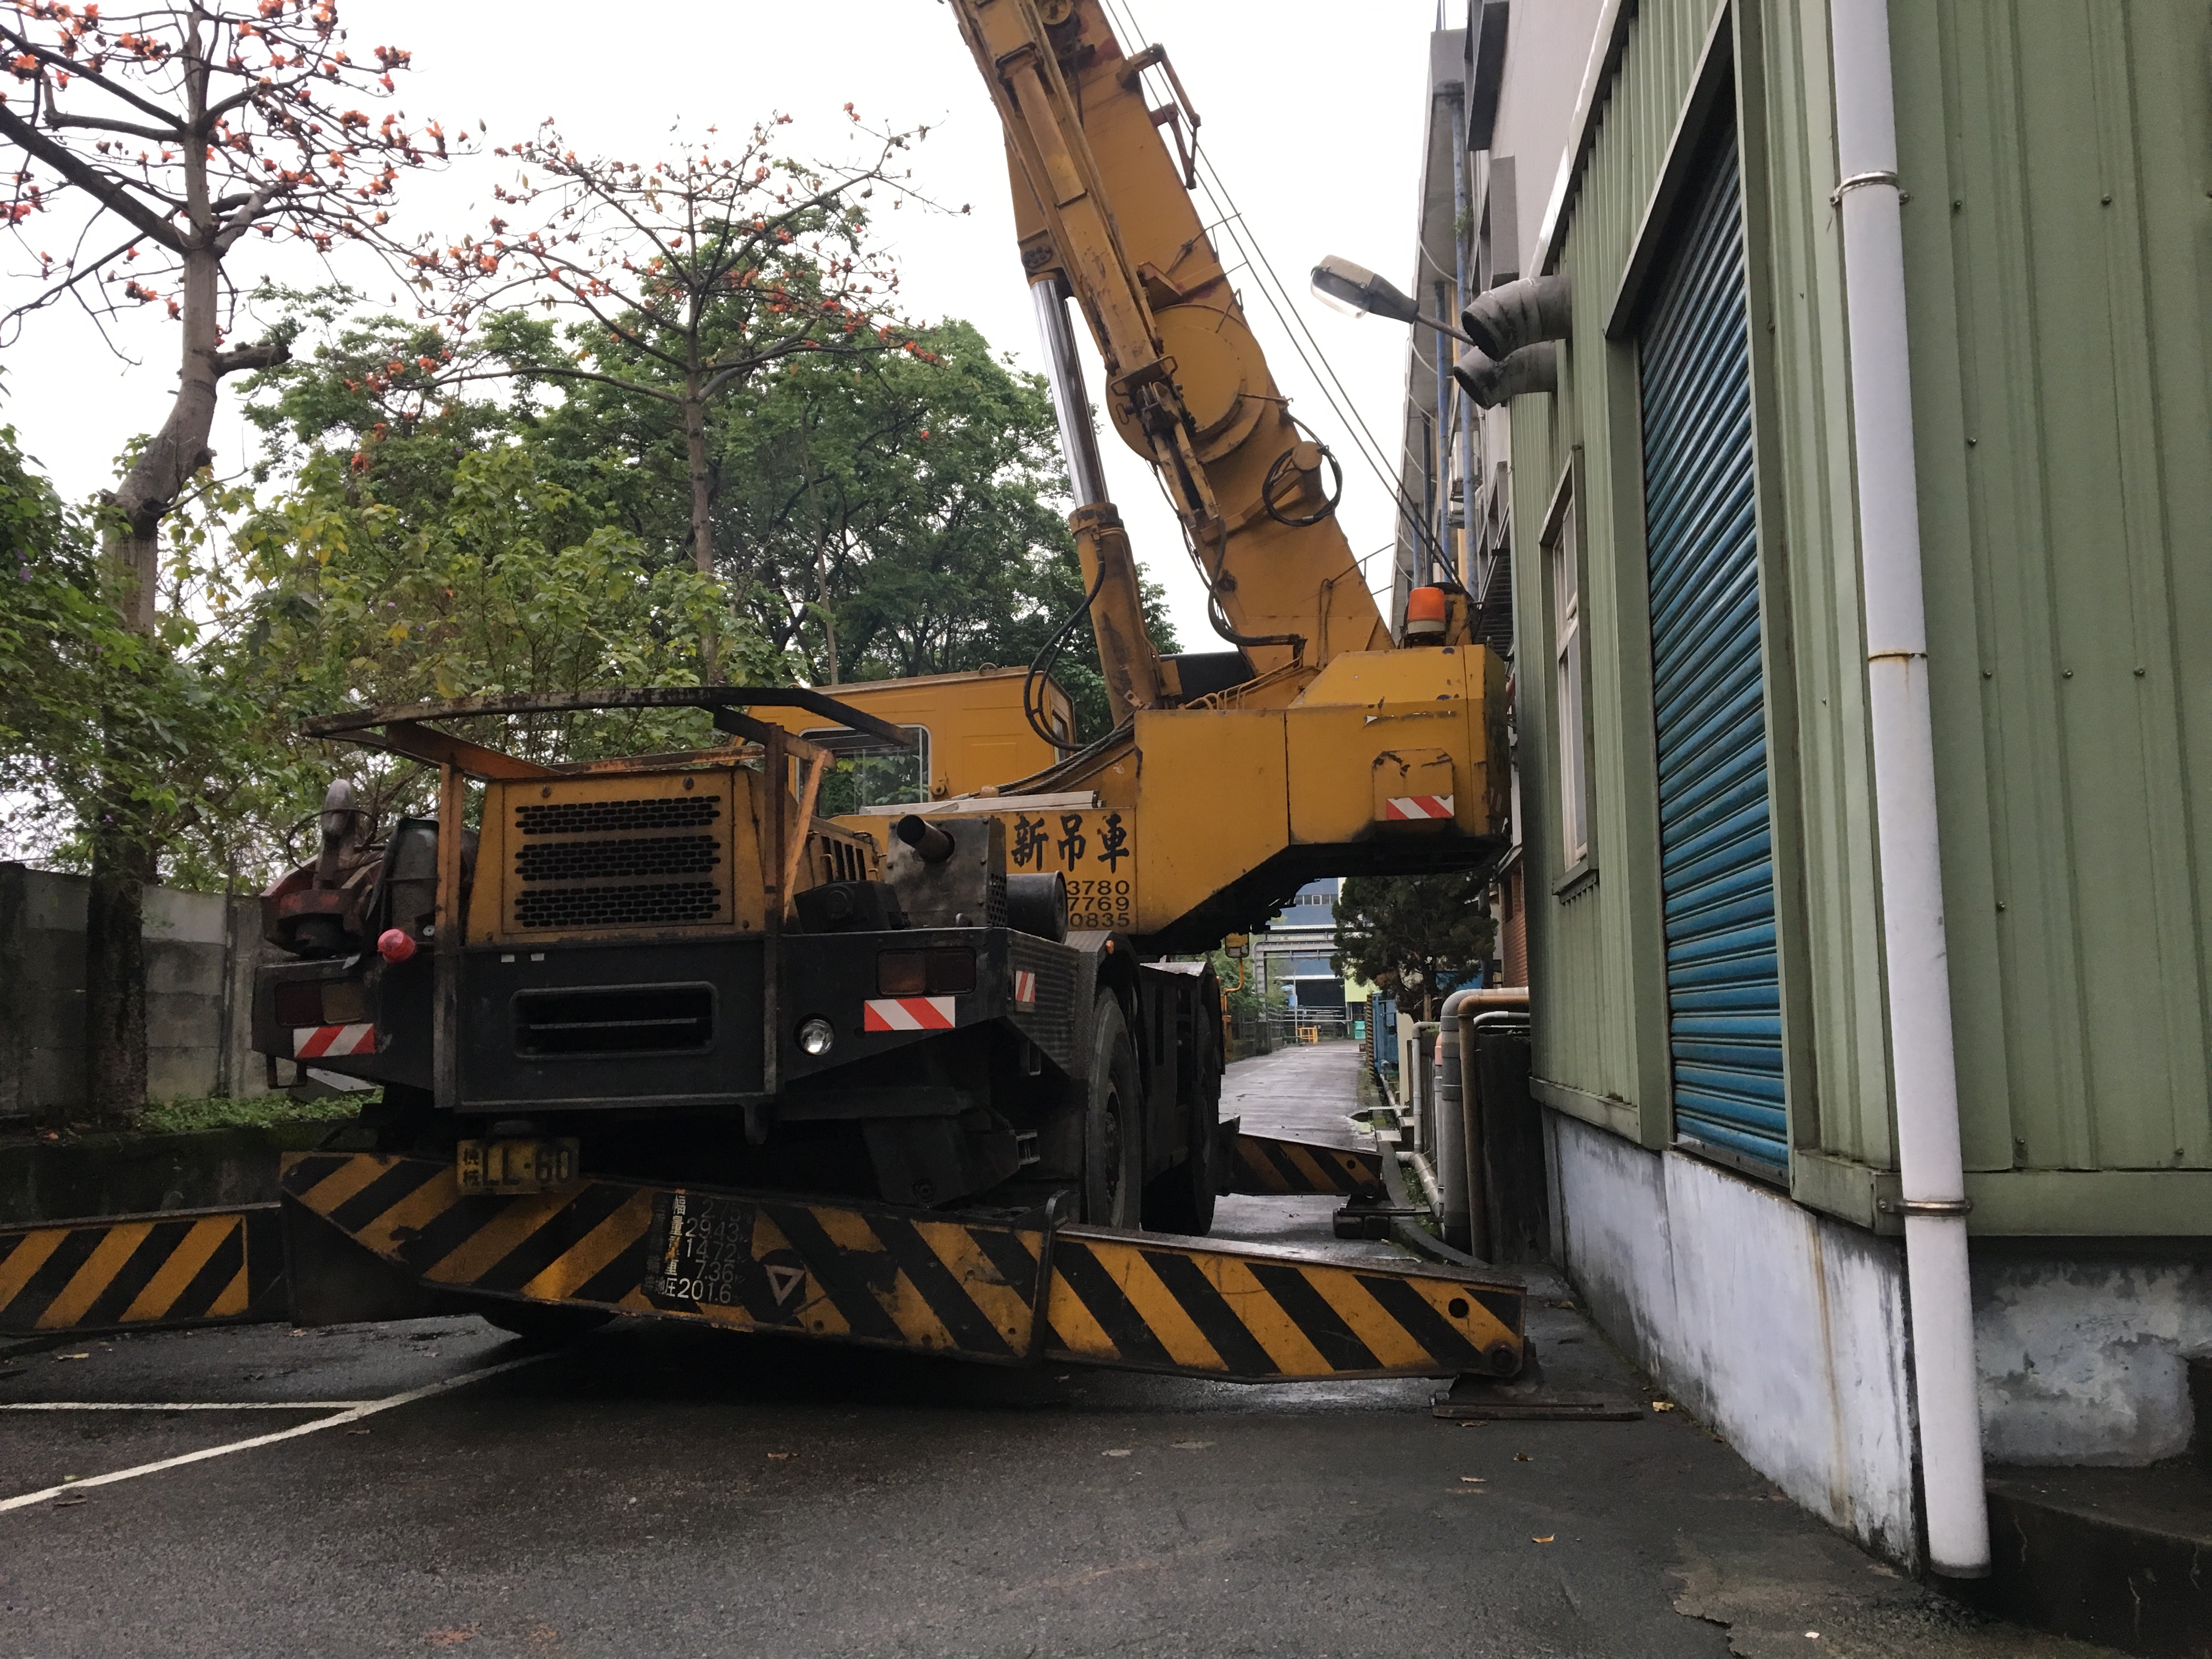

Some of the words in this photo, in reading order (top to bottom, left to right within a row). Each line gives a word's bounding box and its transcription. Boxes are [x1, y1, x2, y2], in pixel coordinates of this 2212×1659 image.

[1011, 813, 1130, 874] 新吊車
[1066, 880, 1130, 895] 3780
[1067, 896, 1130, 911] 7769
[1070, 912, 1130, 927] 0835
